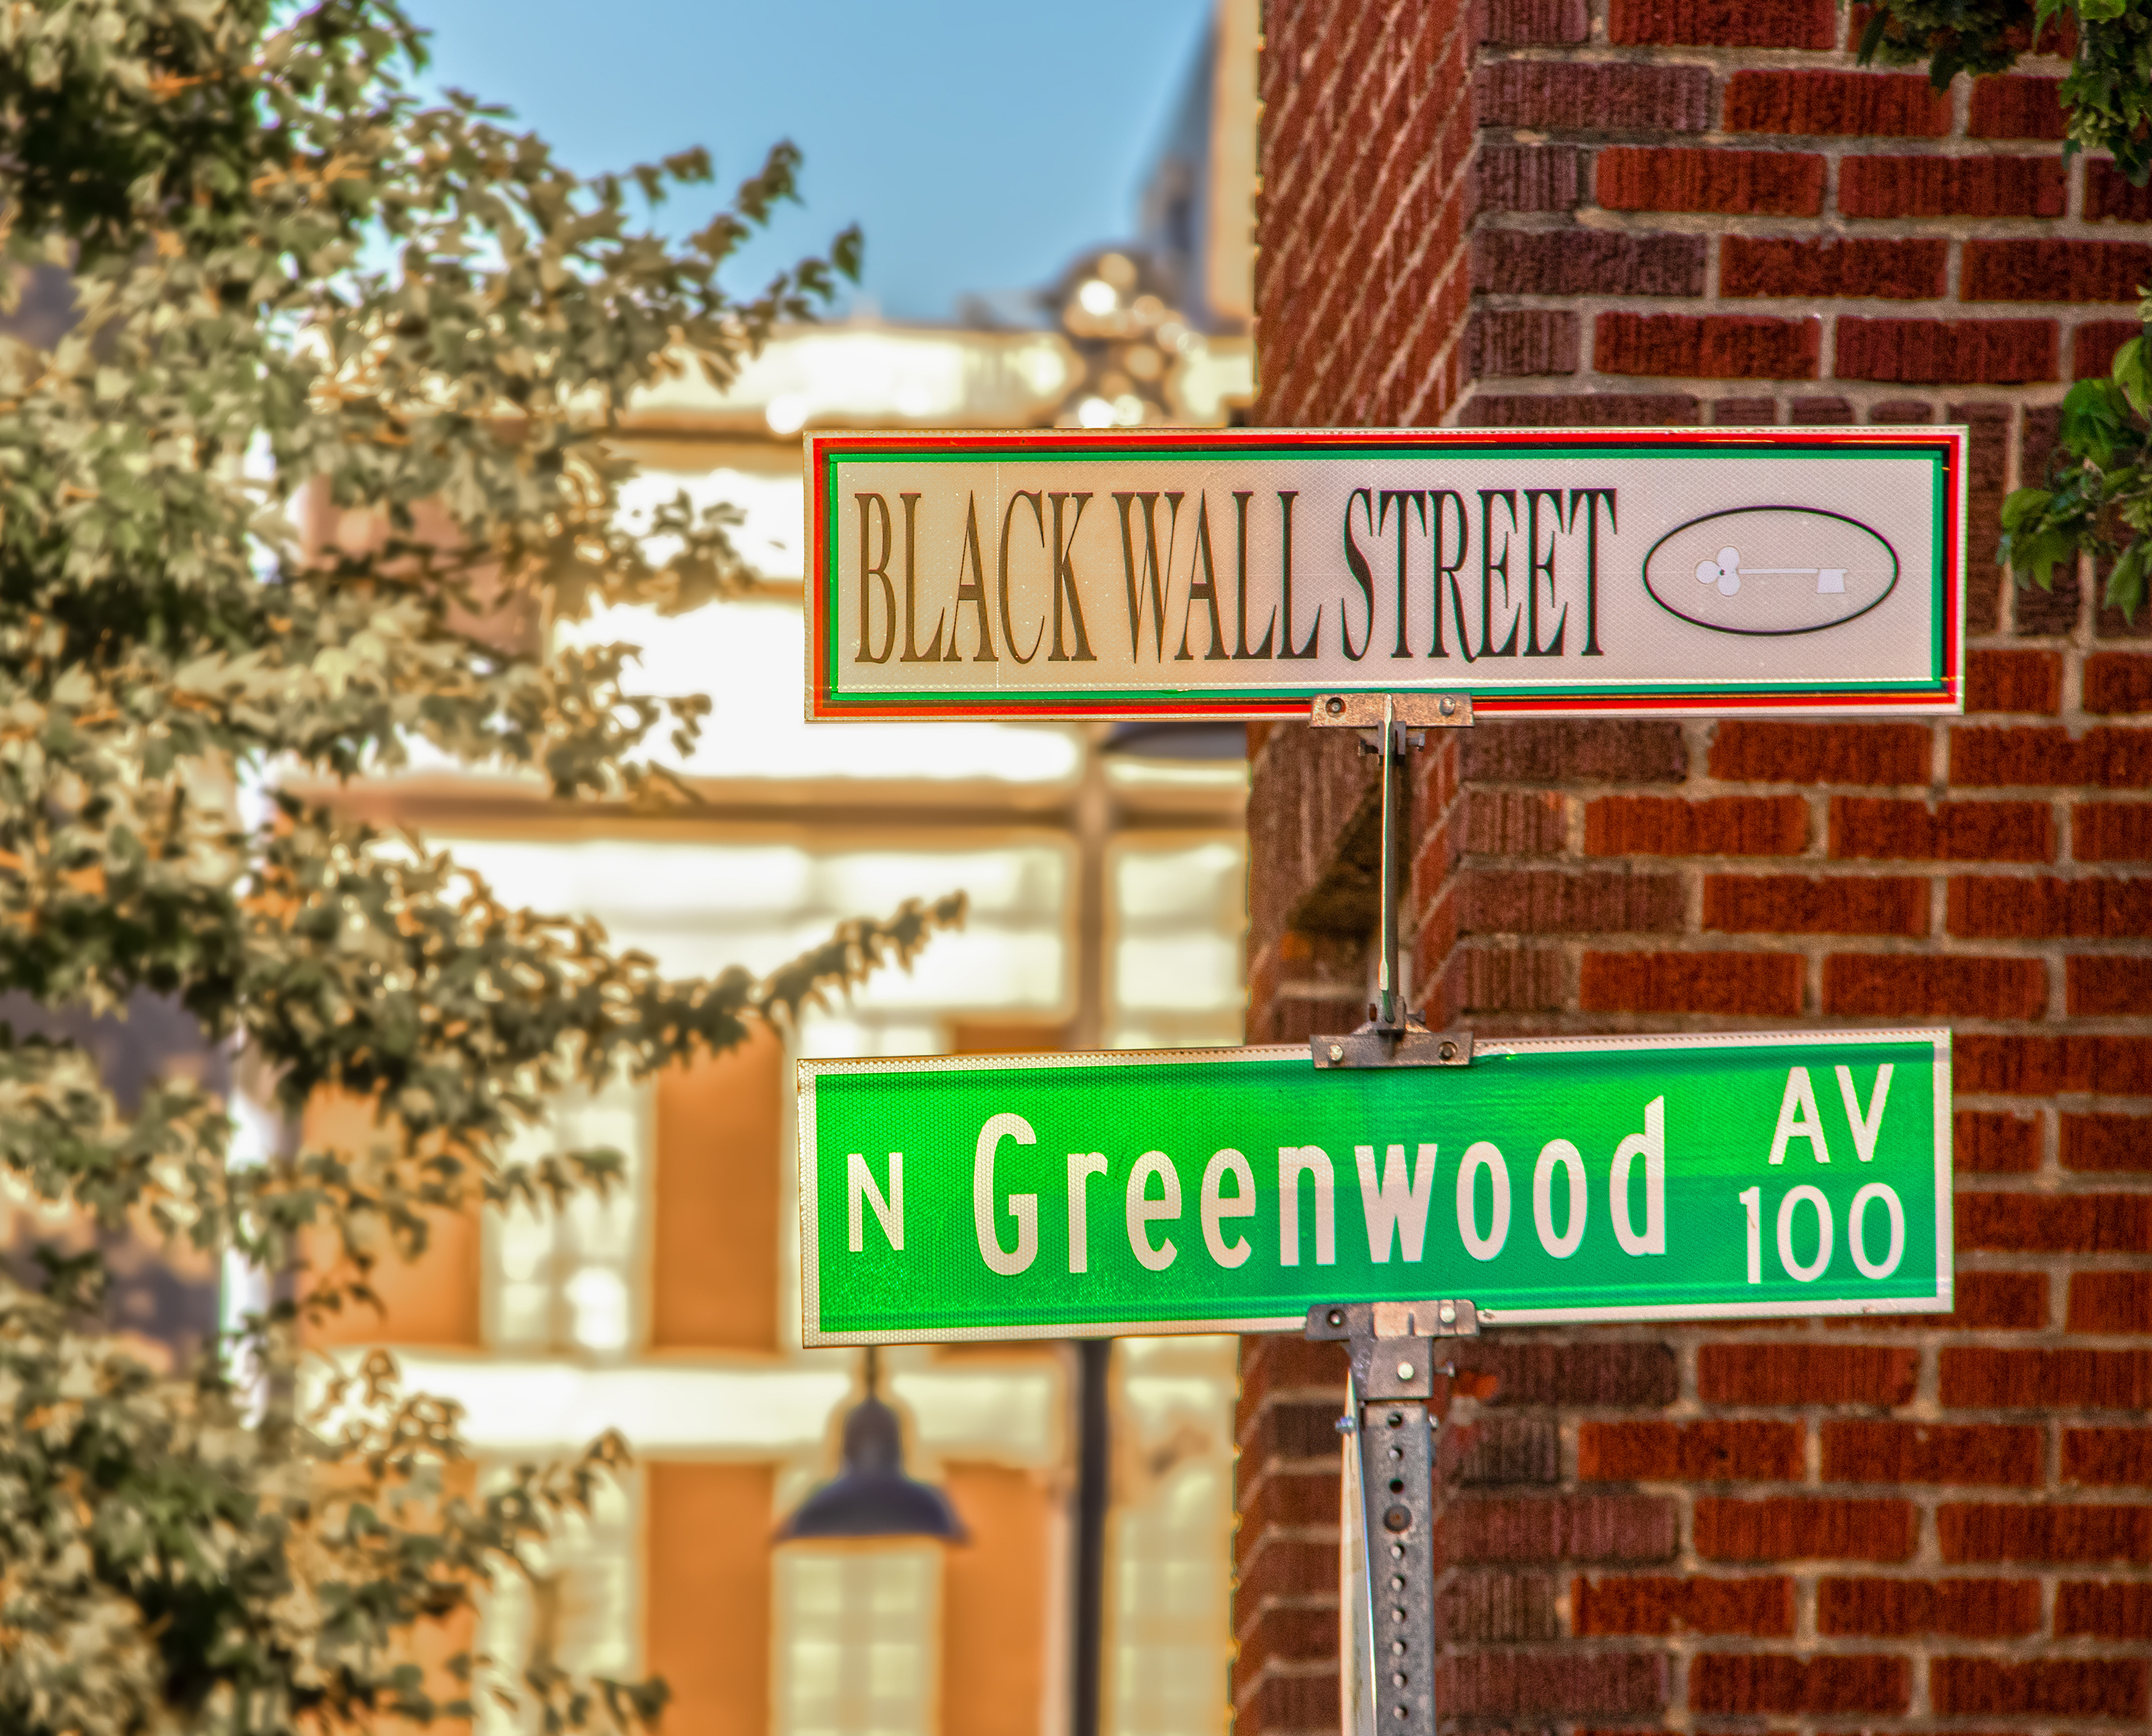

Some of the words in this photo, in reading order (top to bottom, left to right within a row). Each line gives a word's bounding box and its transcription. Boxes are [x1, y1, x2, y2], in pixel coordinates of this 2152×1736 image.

[854, 489, 1097, 664] BLACK
[1112, 488, 1321, 663] WALL
[1342, 487, 1618, 663] STREET
[847, 1151, 904, 1252] N
[973, 1095, 1667, 1276] Greenwood
[1769, 1063, 1894, 1165] AV
[1739, 1182, 1906, 1285] 100
